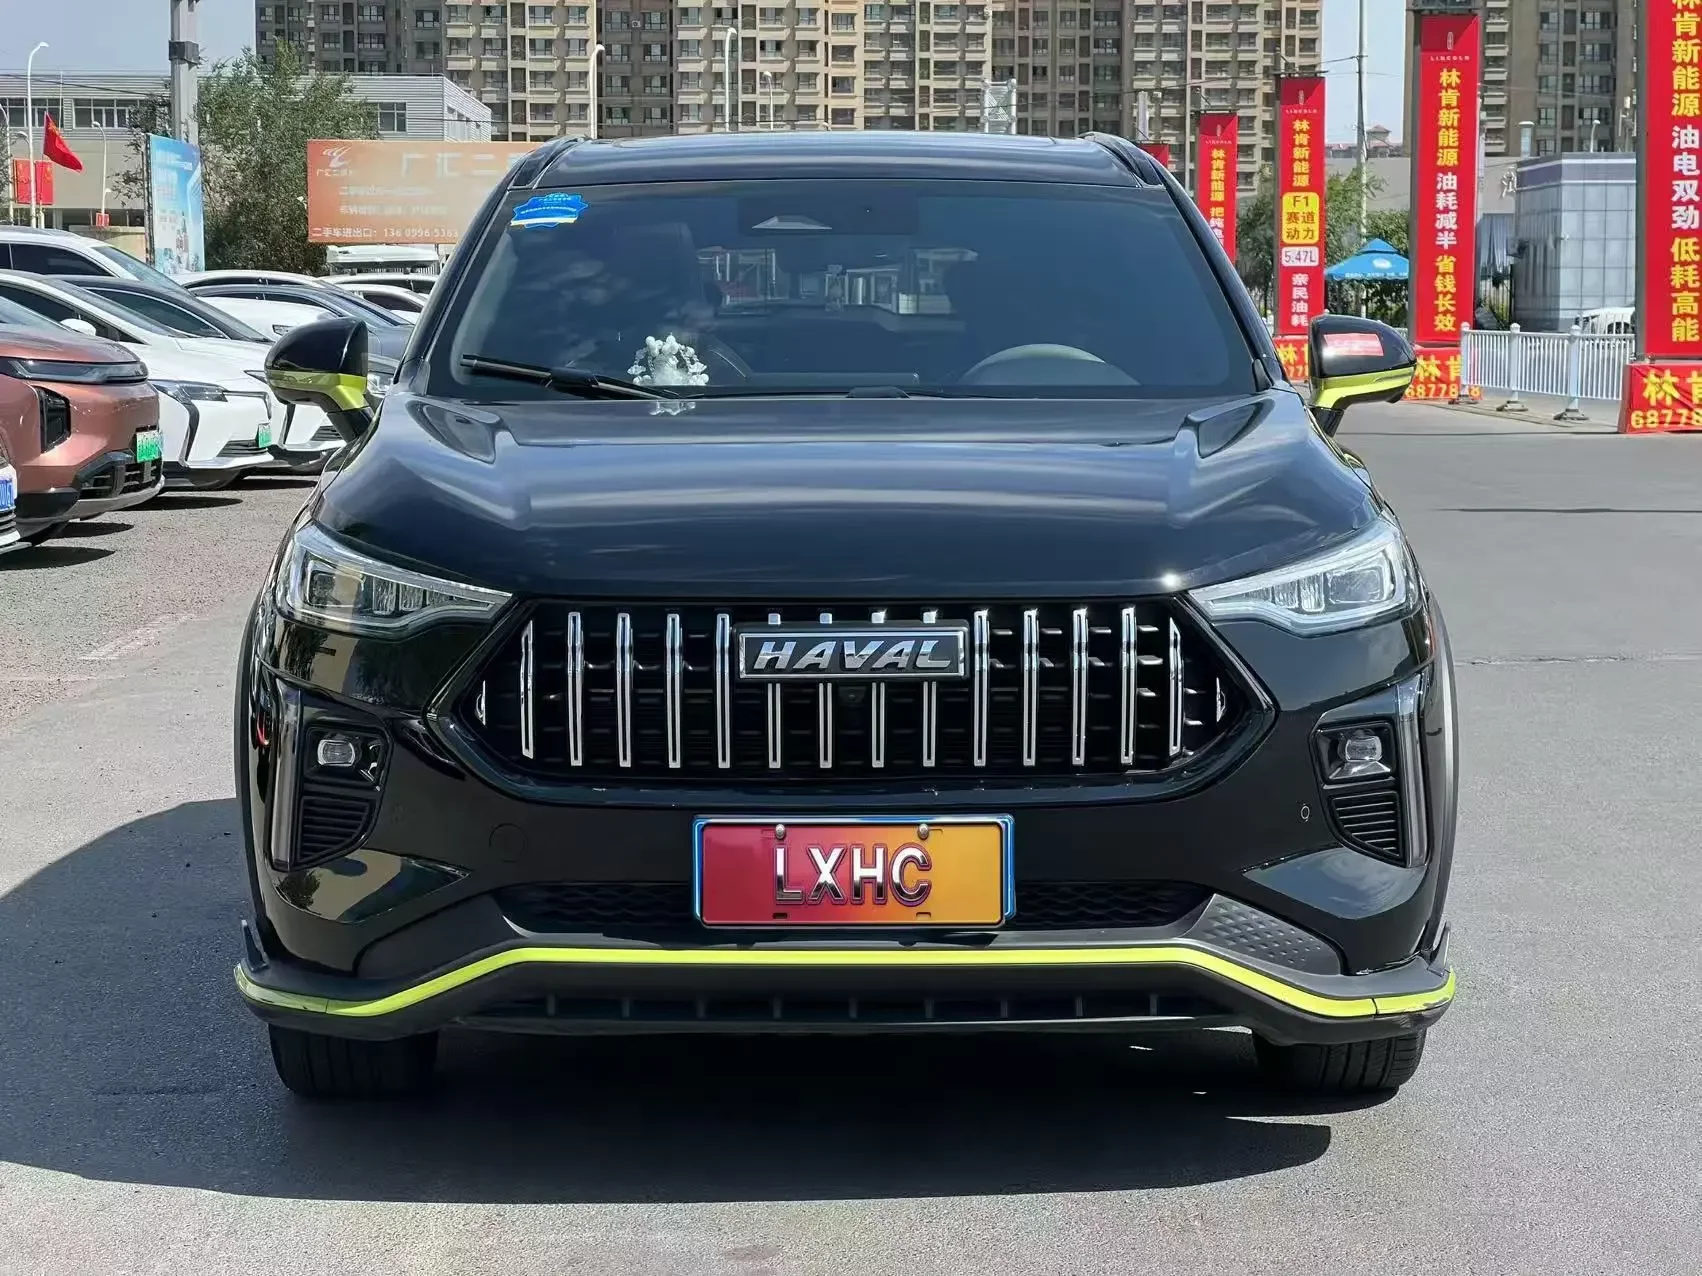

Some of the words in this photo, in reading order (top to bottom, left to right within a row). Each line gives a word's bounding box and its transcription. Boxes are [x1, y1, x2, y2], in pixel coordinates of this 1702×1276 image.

[1436, 67, 1461, 167] 林肯新能源
[401, 151, 525, 178] 广汇二
[1292, 119, 1310, 187] 林肯新能源
[1671, 124, 1701, 230] 油电双劲
[1286, 211, 1315, 224] 赛道
[1293, 196, 1309, 207] F1
[1434, 172, 1459, 250] 油耗减半
[1286, 228, 1315, 241] 动力
[1284, 252, 1317, 264] 5.47L
[1291, 273, 1309, 327] 亲民油耗
[1434, 254, 1457, 332] 省钱长效
[1670, 237, 1701, 342] 低耗高能
[1404, 384, 1481, 398] 687788
[1631, 409, 1702, 429] 68778
[753, 640, 951, 669] HAVAL
[773, 843, 932, 907] LXHC
